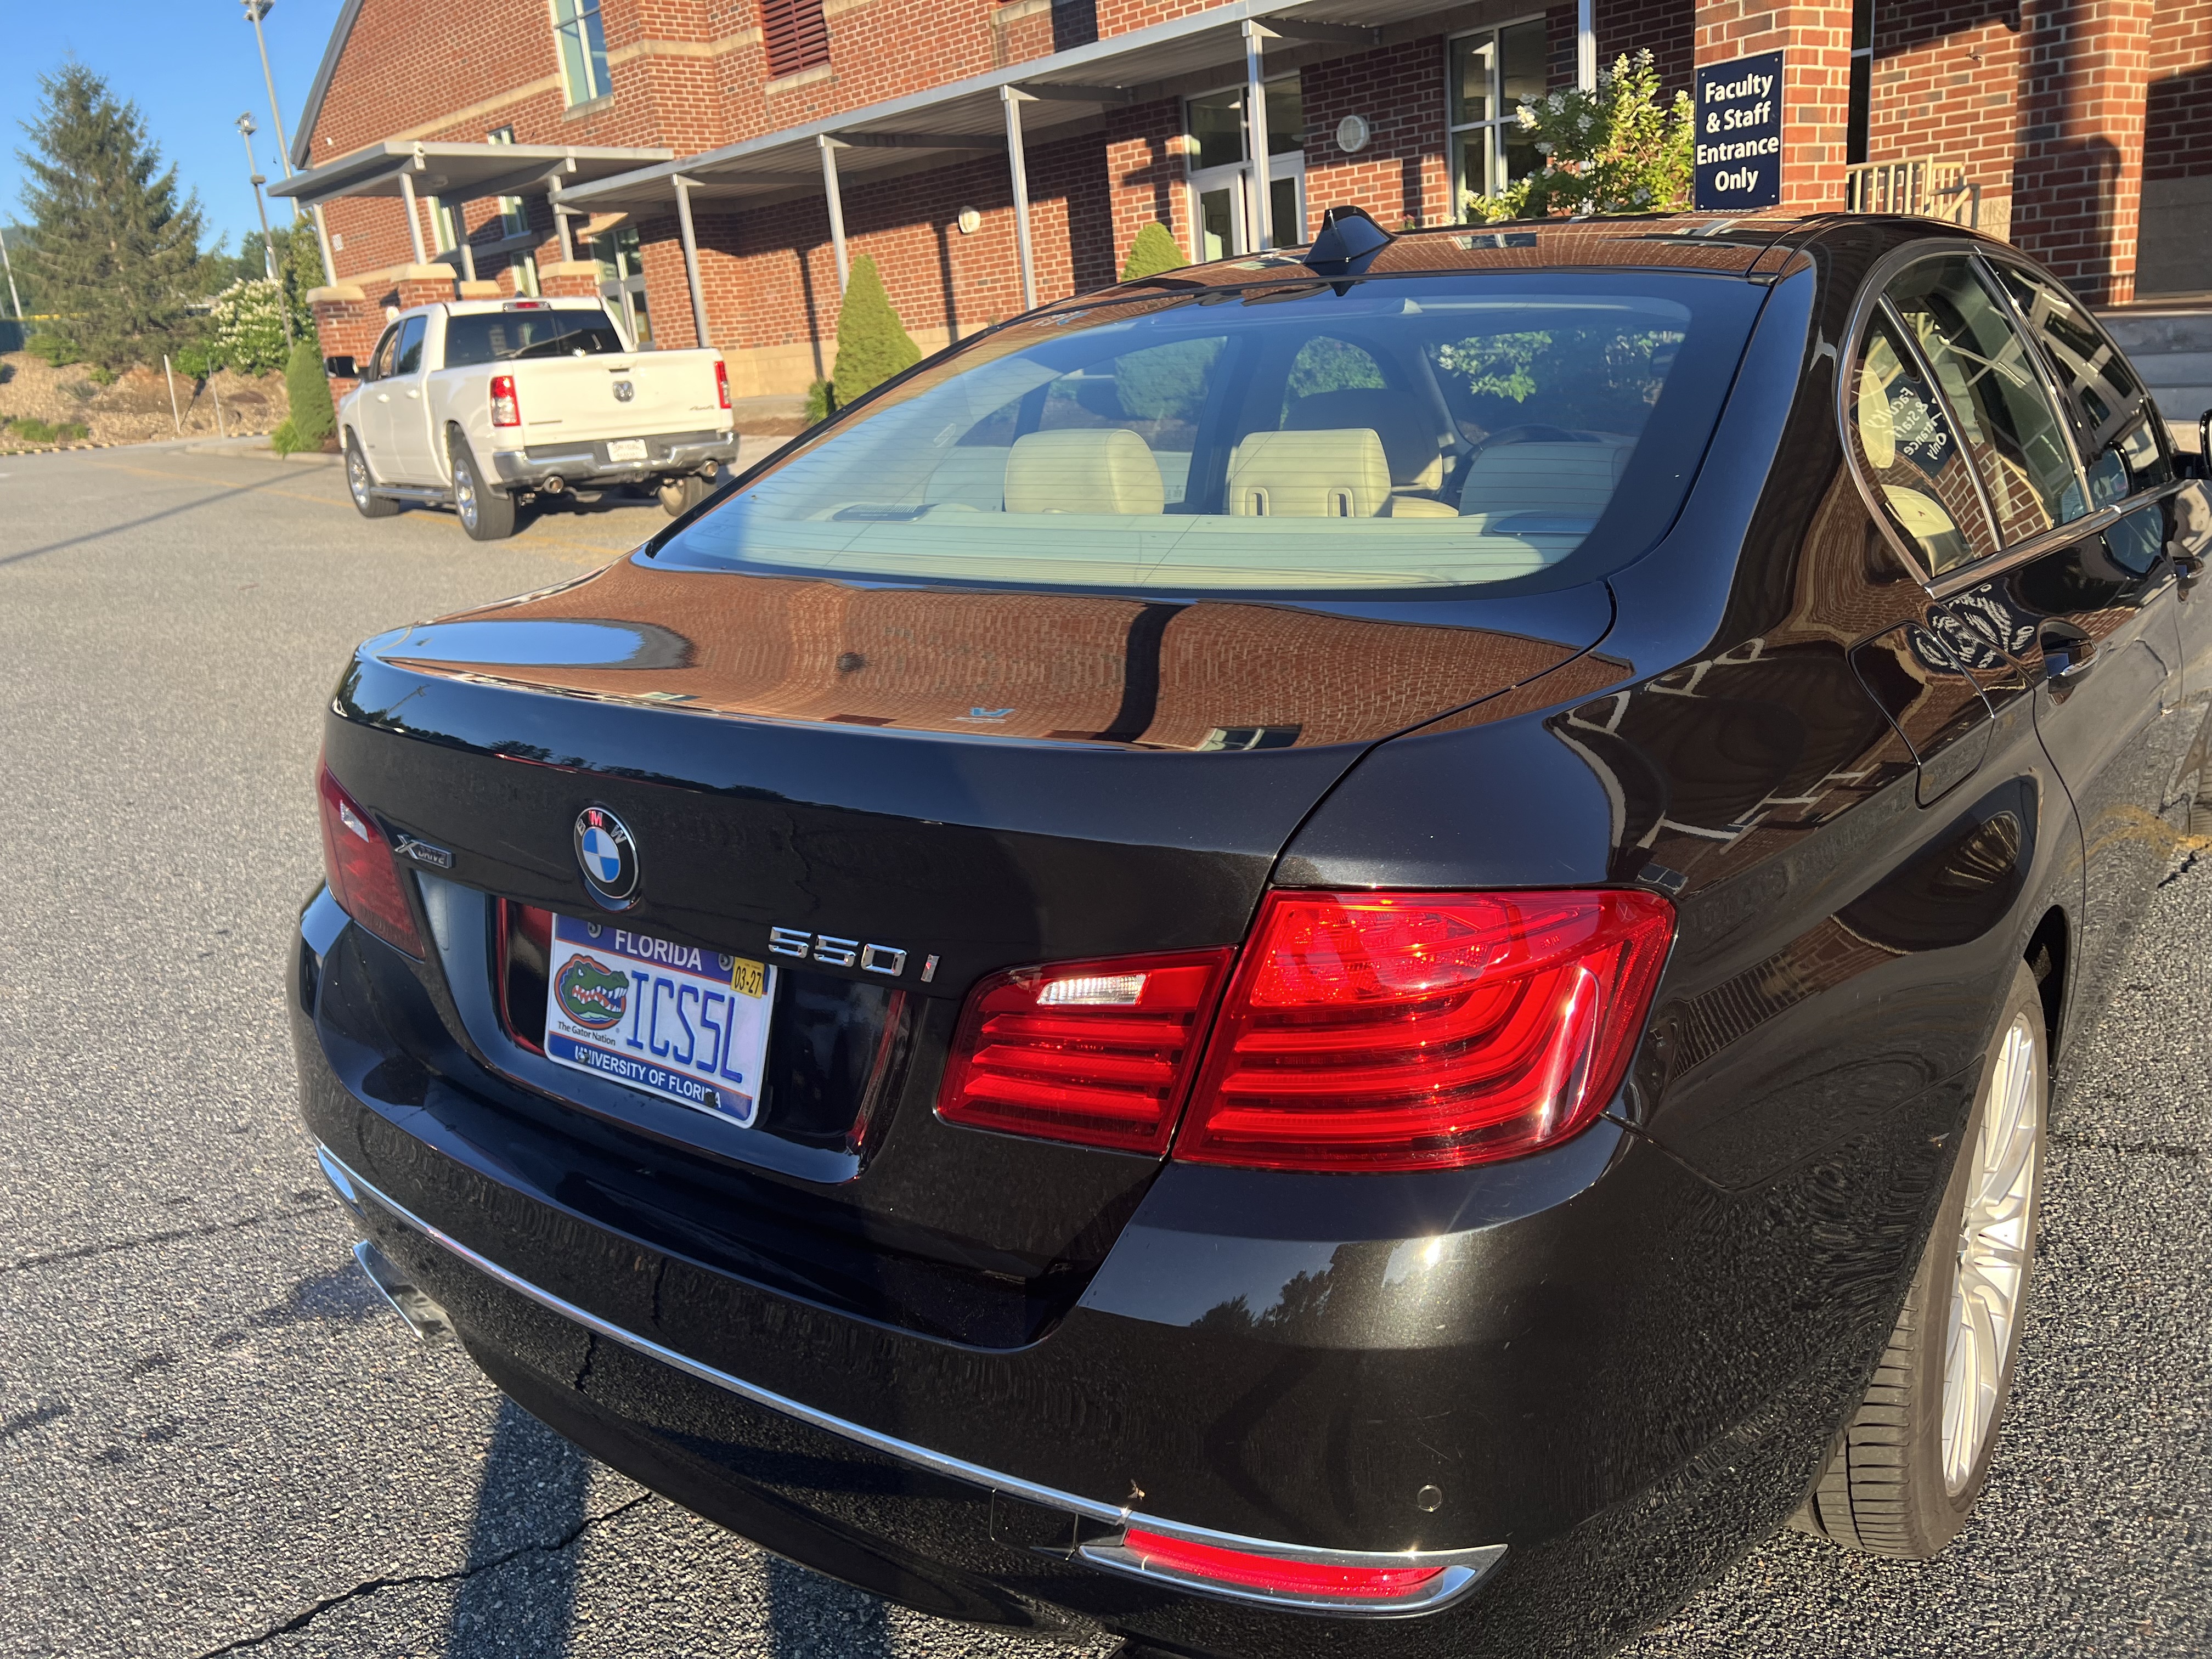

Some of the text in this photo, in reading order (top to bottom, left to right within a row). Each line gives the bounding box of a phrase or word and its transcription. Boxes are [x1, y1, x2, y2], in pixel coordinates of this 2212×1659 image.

[1705, 73, 1773, 103] Faculty
[1706, 100, 1771, 133] & Staff
[1697, 136, 1779, 165] Entrance
[1715, 167, 1758, 193] Only
[577, 810, 627, 844] BMW
[615, 929, 702, 970] FLORIDA
[735, 966, 761, 995] 03-27
[557, 1022, 616, 1046] The Gator Nation
[627, 970, 742, 1083] ICS5L
[648, 1069, 665, 1086] OF
